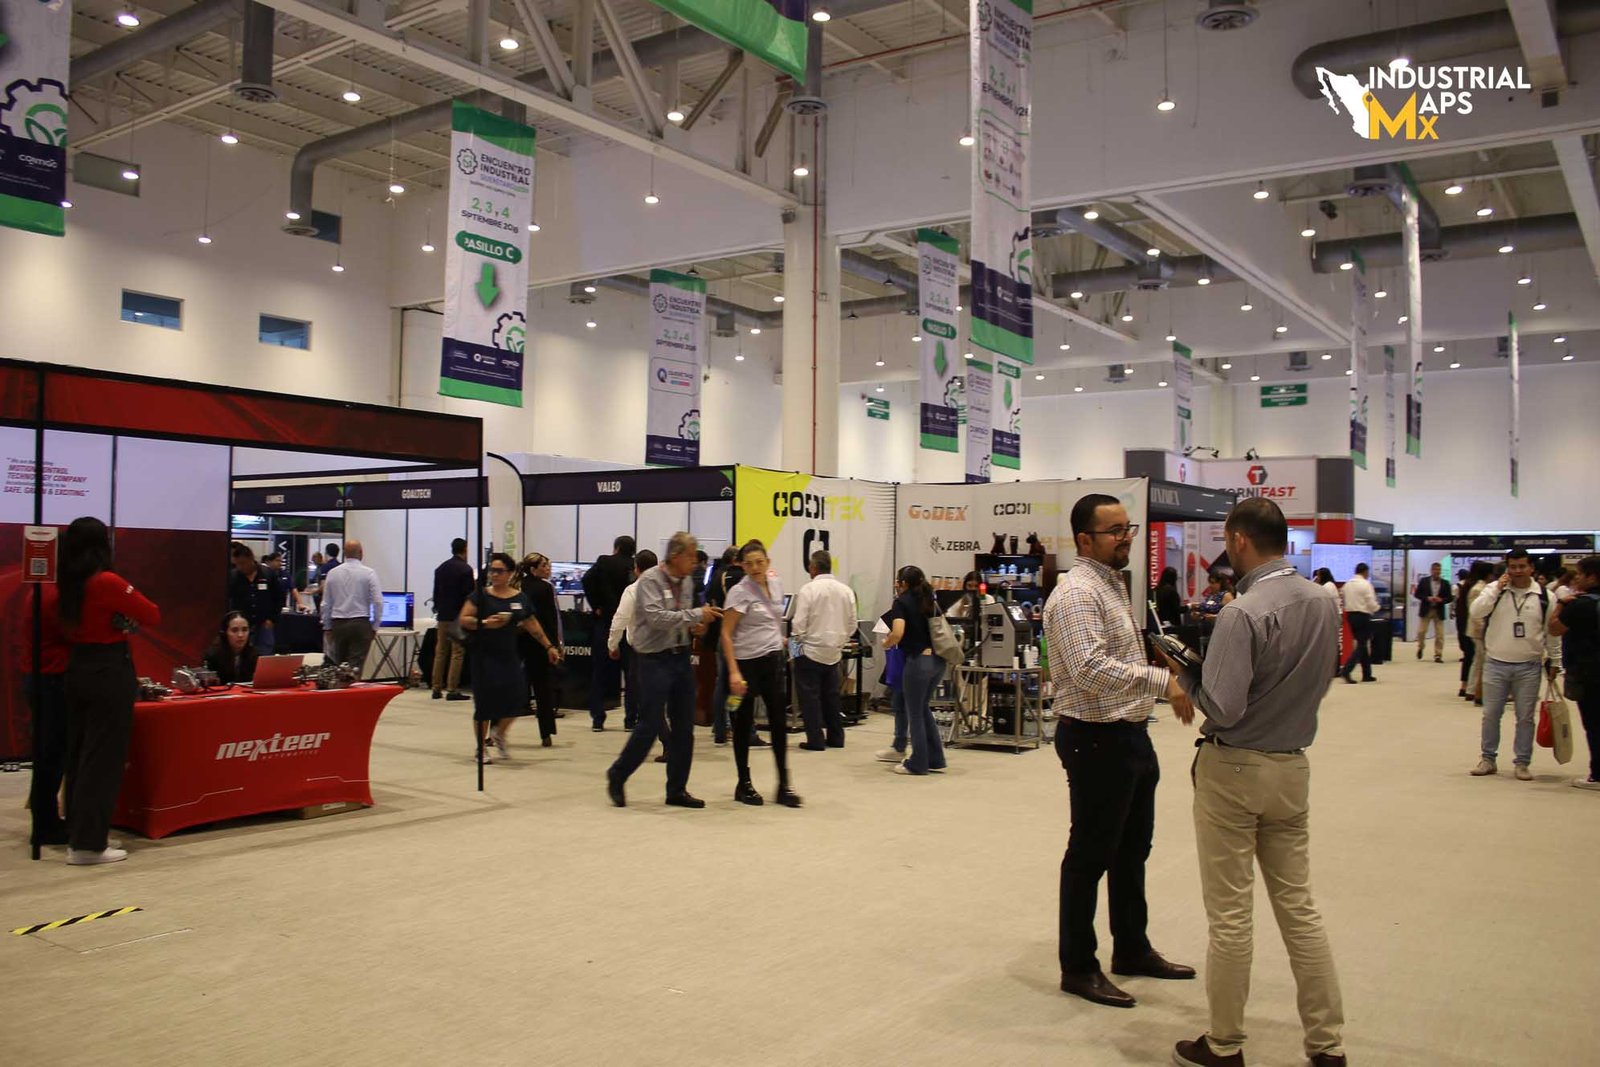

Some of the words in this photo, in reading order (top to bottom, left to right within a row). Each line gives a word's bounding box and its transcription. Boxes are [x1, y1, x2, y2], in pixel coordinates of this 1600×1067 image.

[480, 153, 531, 176] ENCUENTRO
[480, 163, 530, 186] INDUSTRIAL
[501, 207, 510, 218] 4
[505, 247, 514, 259] C
[597, 481, 621, 492] VALEO
[946, 541, 981, 551] ZEBRA
[216, 732, 331, 762] nexteer
